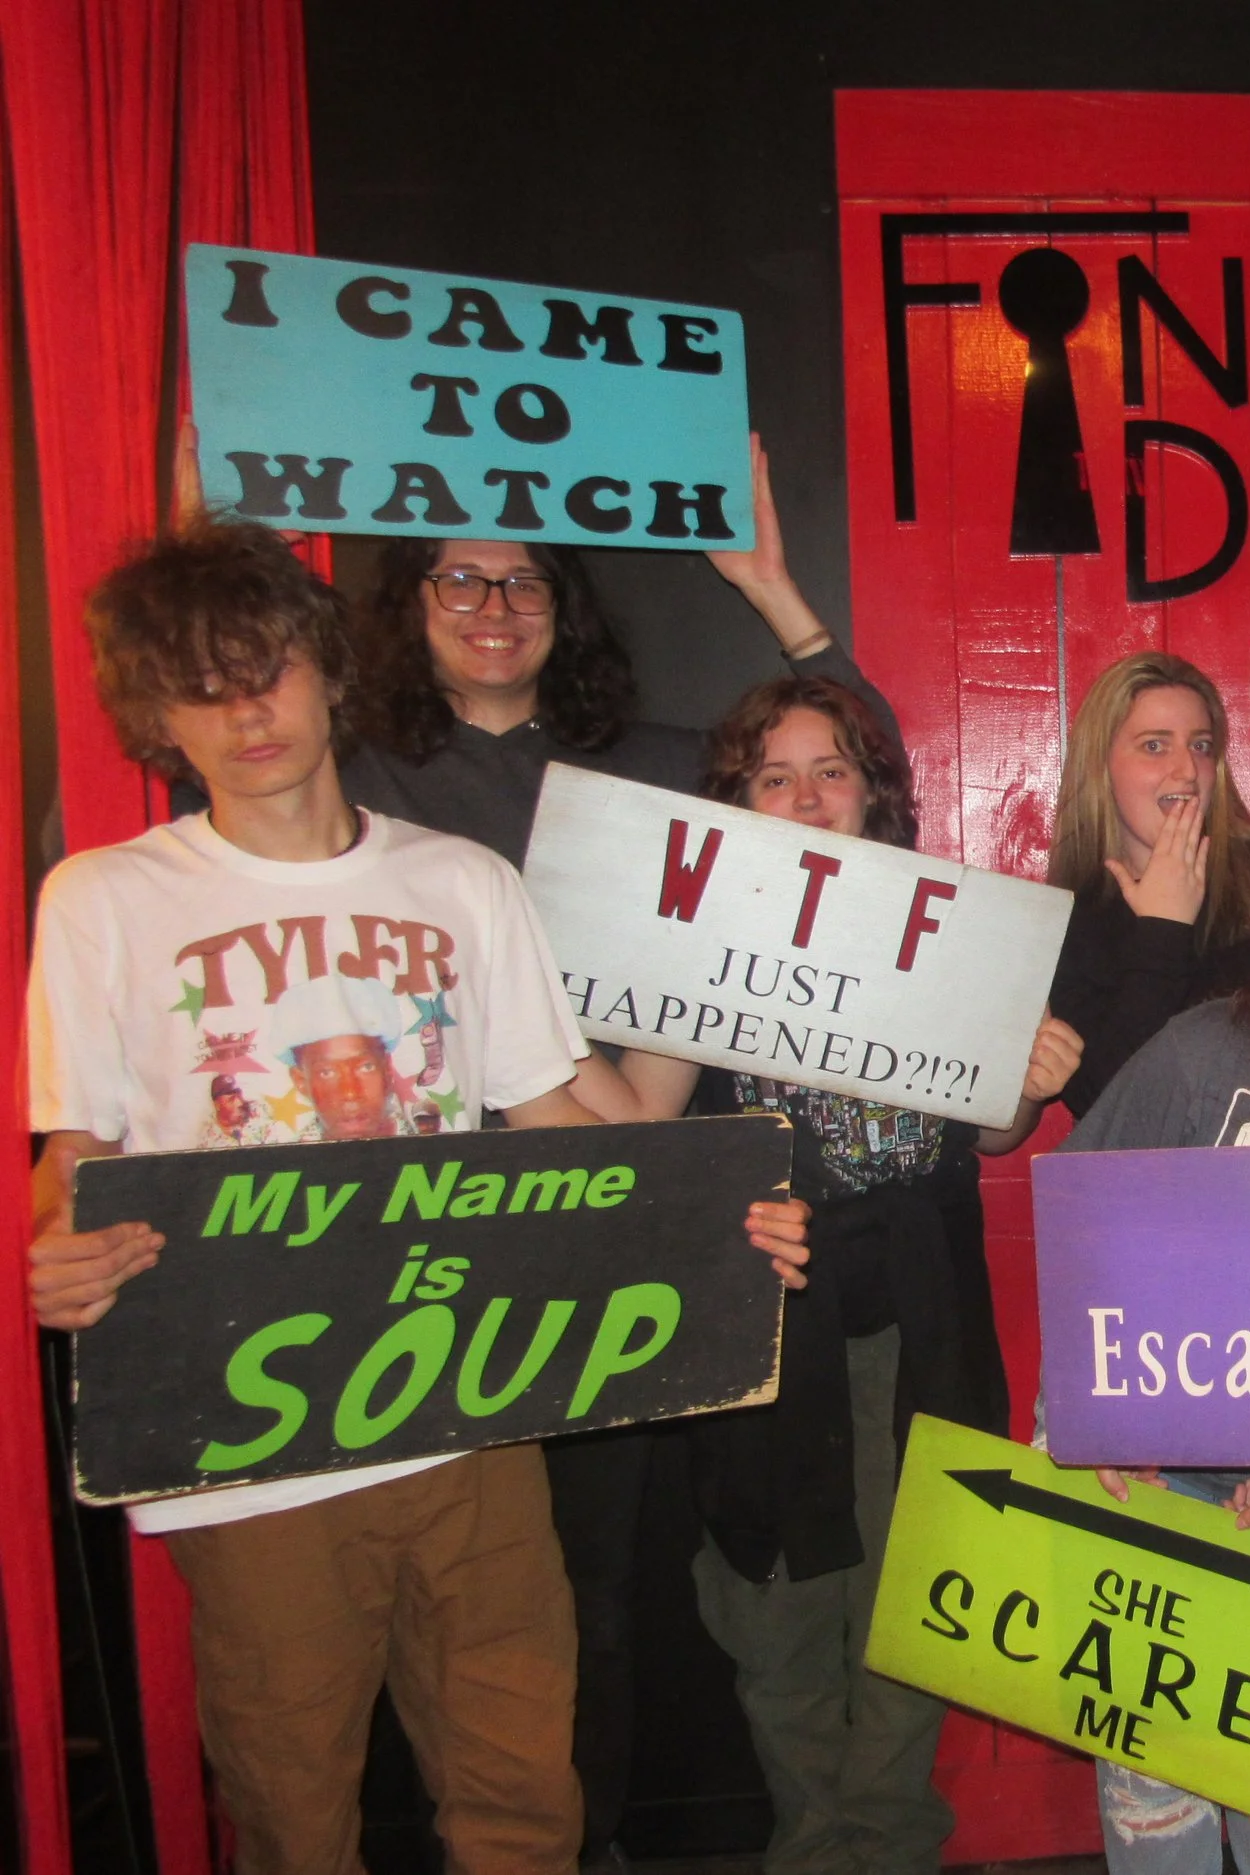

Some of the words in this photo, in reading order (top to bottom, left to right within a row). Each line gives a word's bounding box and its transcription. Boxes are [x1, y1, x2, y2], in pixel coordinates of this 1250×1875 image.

[222, 260, 278, 327] I
[336, 276, 723, 375] CAME
[410, 372, 571, 444] TO
[225, 451, 736, 540] WATCH
[708, 947, 860, 1014] JUST
[200, 1171, 362, 1247] My
[380, 1161, 636, 1224] Name
[388, 1244, 471, 1303] is
[195, 1282, 682, 1471] SOUP
[1088, 1569, 1192, 1638] SHE
[1074, 1695, 1152, 1760] ME
